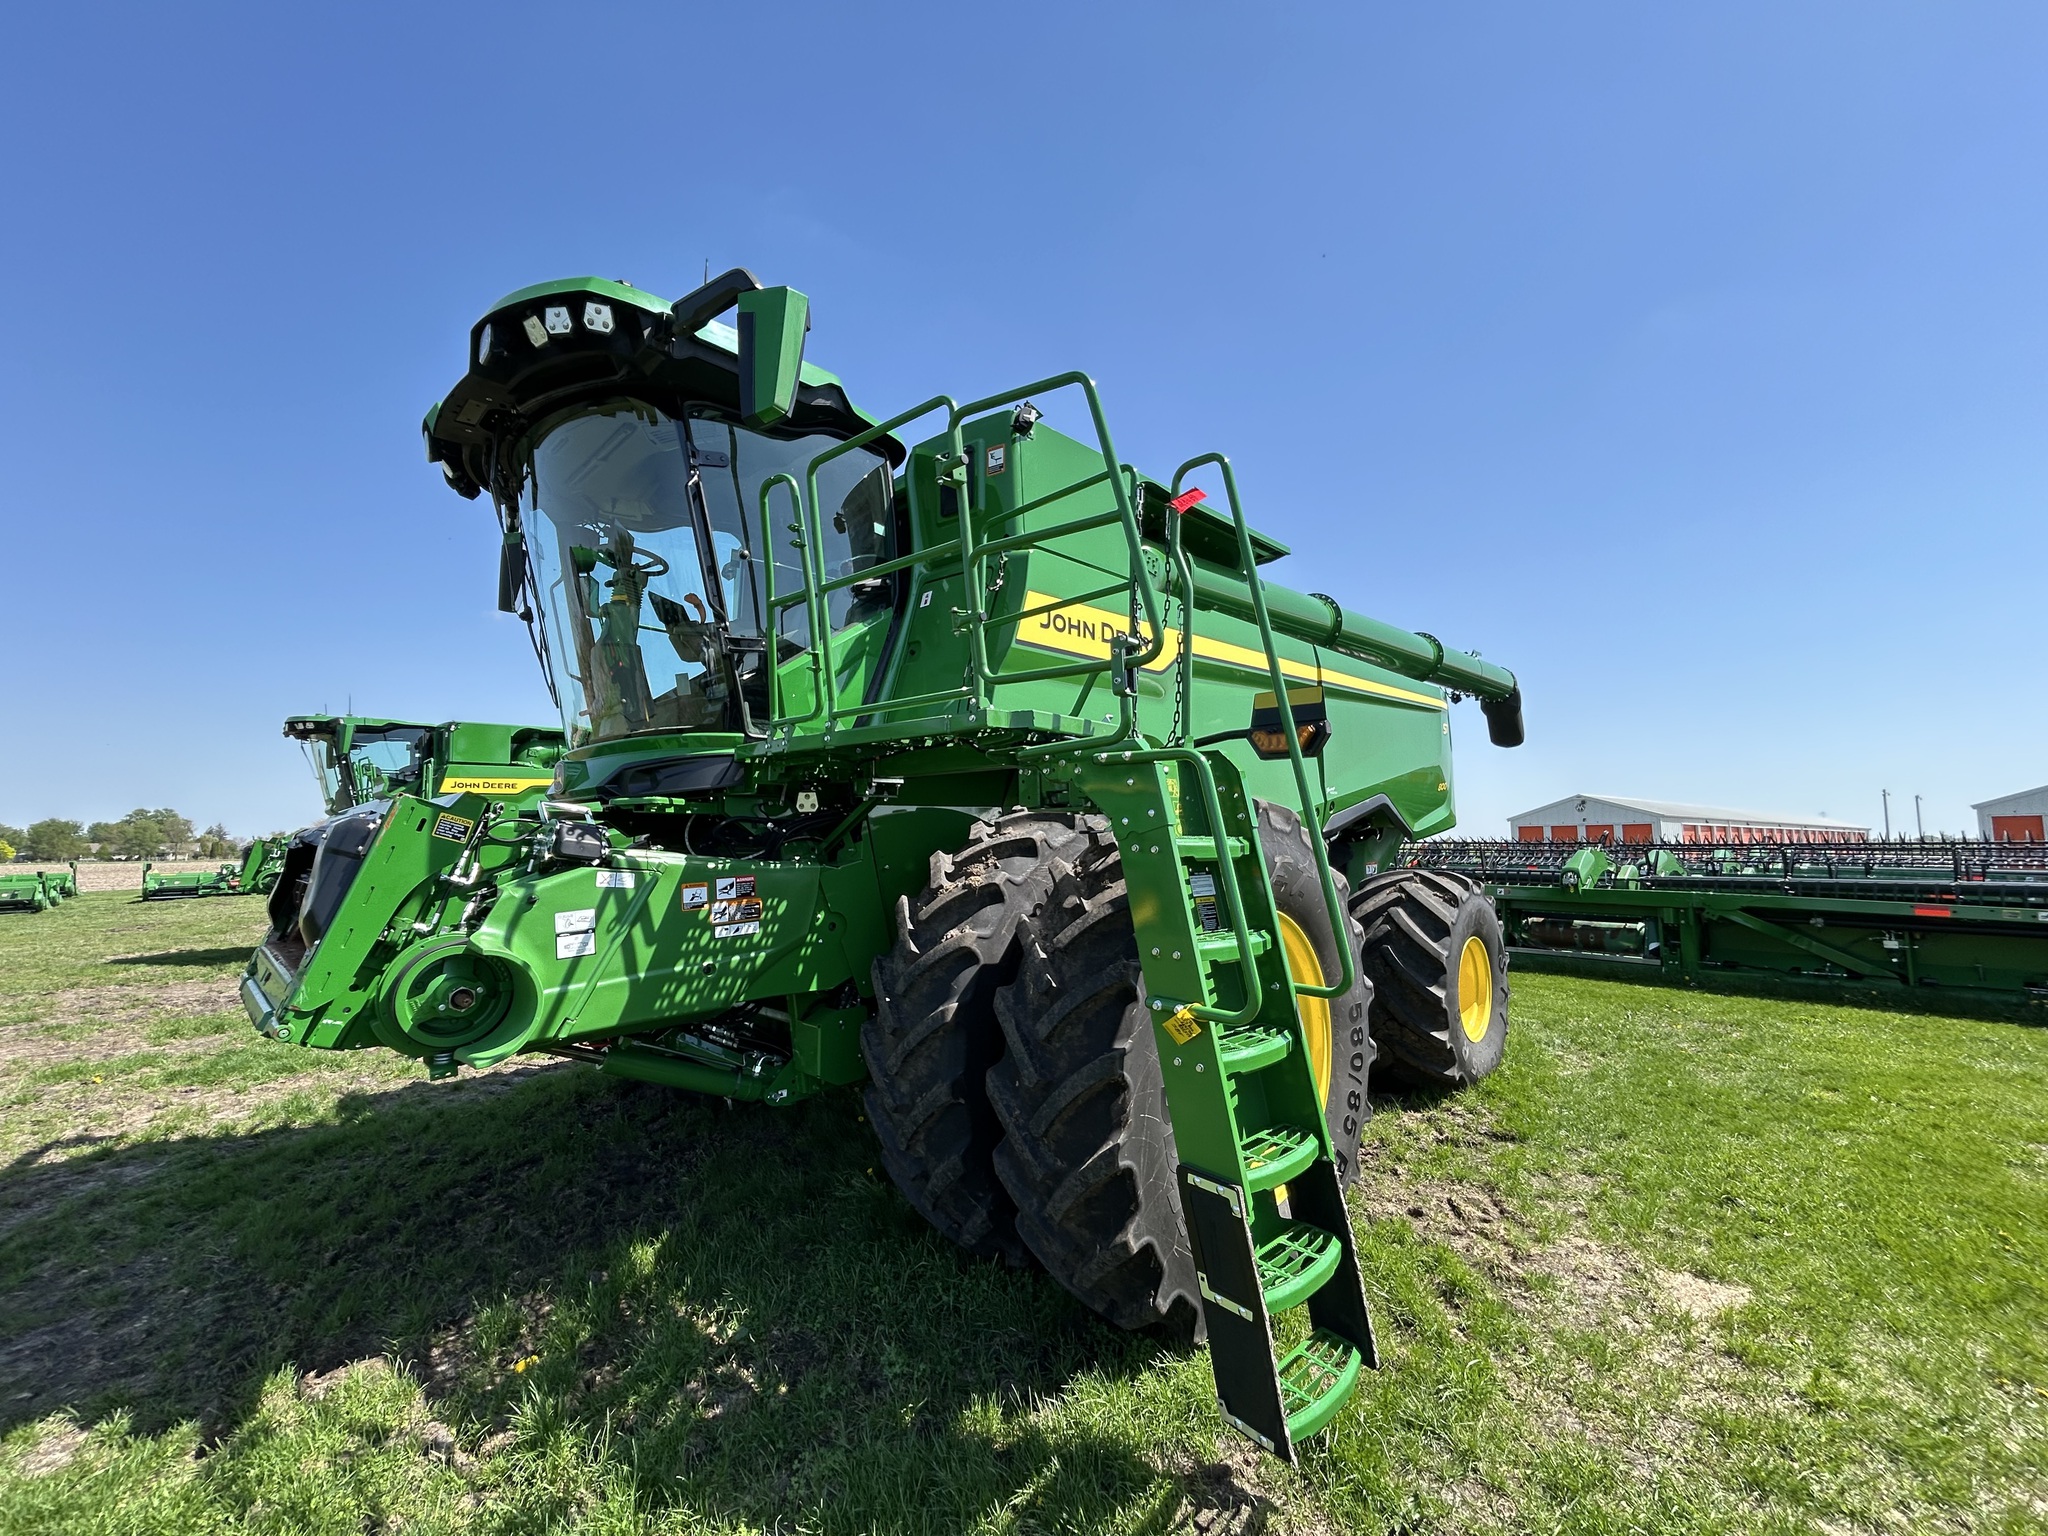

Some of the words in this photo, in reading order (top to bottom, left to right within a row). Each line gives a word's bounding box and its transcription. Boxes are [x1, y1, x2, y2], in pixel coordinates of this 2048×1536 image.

[1040, 610, 1096, 641] JOHN
[450, 781, 480, 789] JOHN
[482, 781, 518, 790] DEERE
[445, 815, 473, 825] CAUTION
[1342, 1001, 1364, 1139] 580/85
